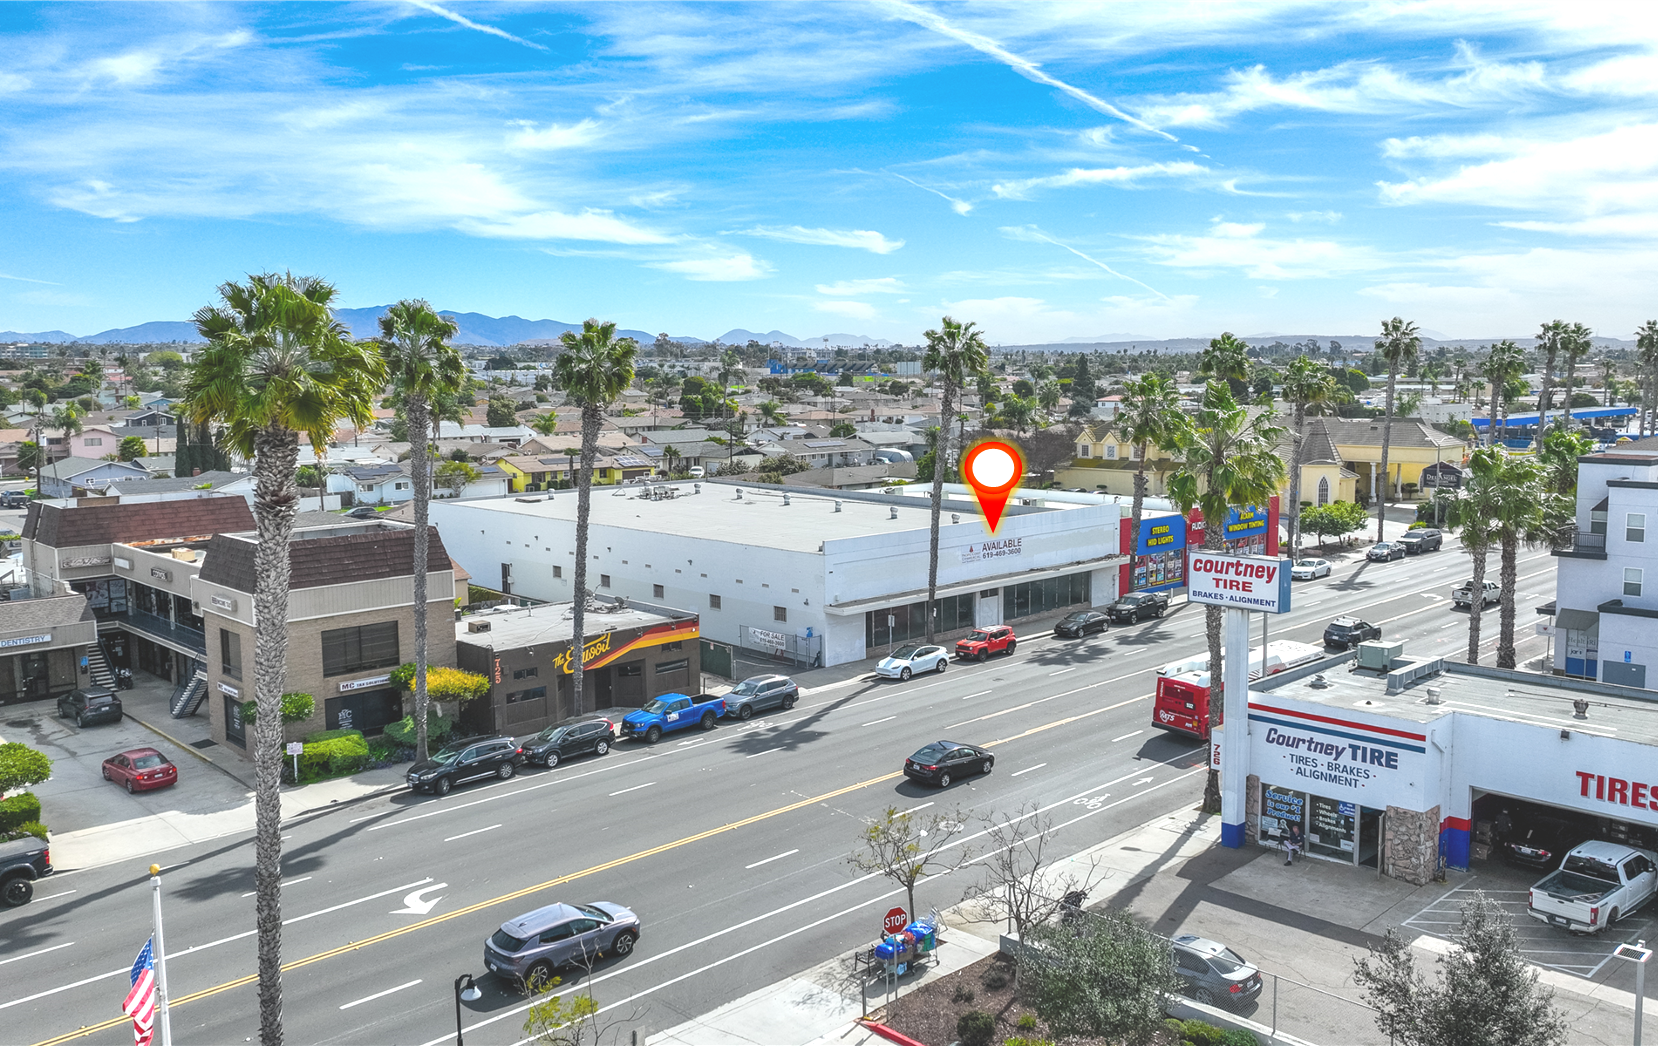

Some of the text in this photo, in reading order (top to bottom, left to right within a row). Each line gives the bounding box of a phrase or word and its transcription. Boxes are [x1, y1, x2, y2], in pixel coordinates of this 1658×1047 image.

[1240, 511, 1254, 521] ALARM
[1152, 525, 1170, 535] STEREO
[1228, 520, 1265, 532] WINDOW TINTING
[982, 538, 1022, 552] AVAILABLE
[1147, 535, 1174, 547] HID LIGHTS
[982, 547, 1022, 559] 619-469-3600
[1212, 577, 1253, 593] TIRE
[1192, 590, 1276, 608] BRAKES ALIGNMENT
[1, 635, 46, 647] DENTISTRY
[760, 630, 785, 641] FOR SALE
[563, 632, 611, 675] Ewood
[552, 653, 565, 669] The
[342, 682, 355, 690] MC
[1213, 744, 1221, 766] 726
[1266, 727, 1399, 770] Courtney TIRE
[1289, 753, 1371, 779] TIRES BRAKES
[1295, 766, 1359, 789] ALIGNMENT
[1265, 789, 1304, 806] Service
[1266, 799, 1274, 807] is
[1275, 803, 1290, 811] our
[1319, 802, 1332, 810] Tires
[1266, 807, 1302, 822] Product!
[1319, 808, 1338, 818] Wheels
[1318, 816, 1336, 825] Brakes
[885, 913, 906, 928] STOP
